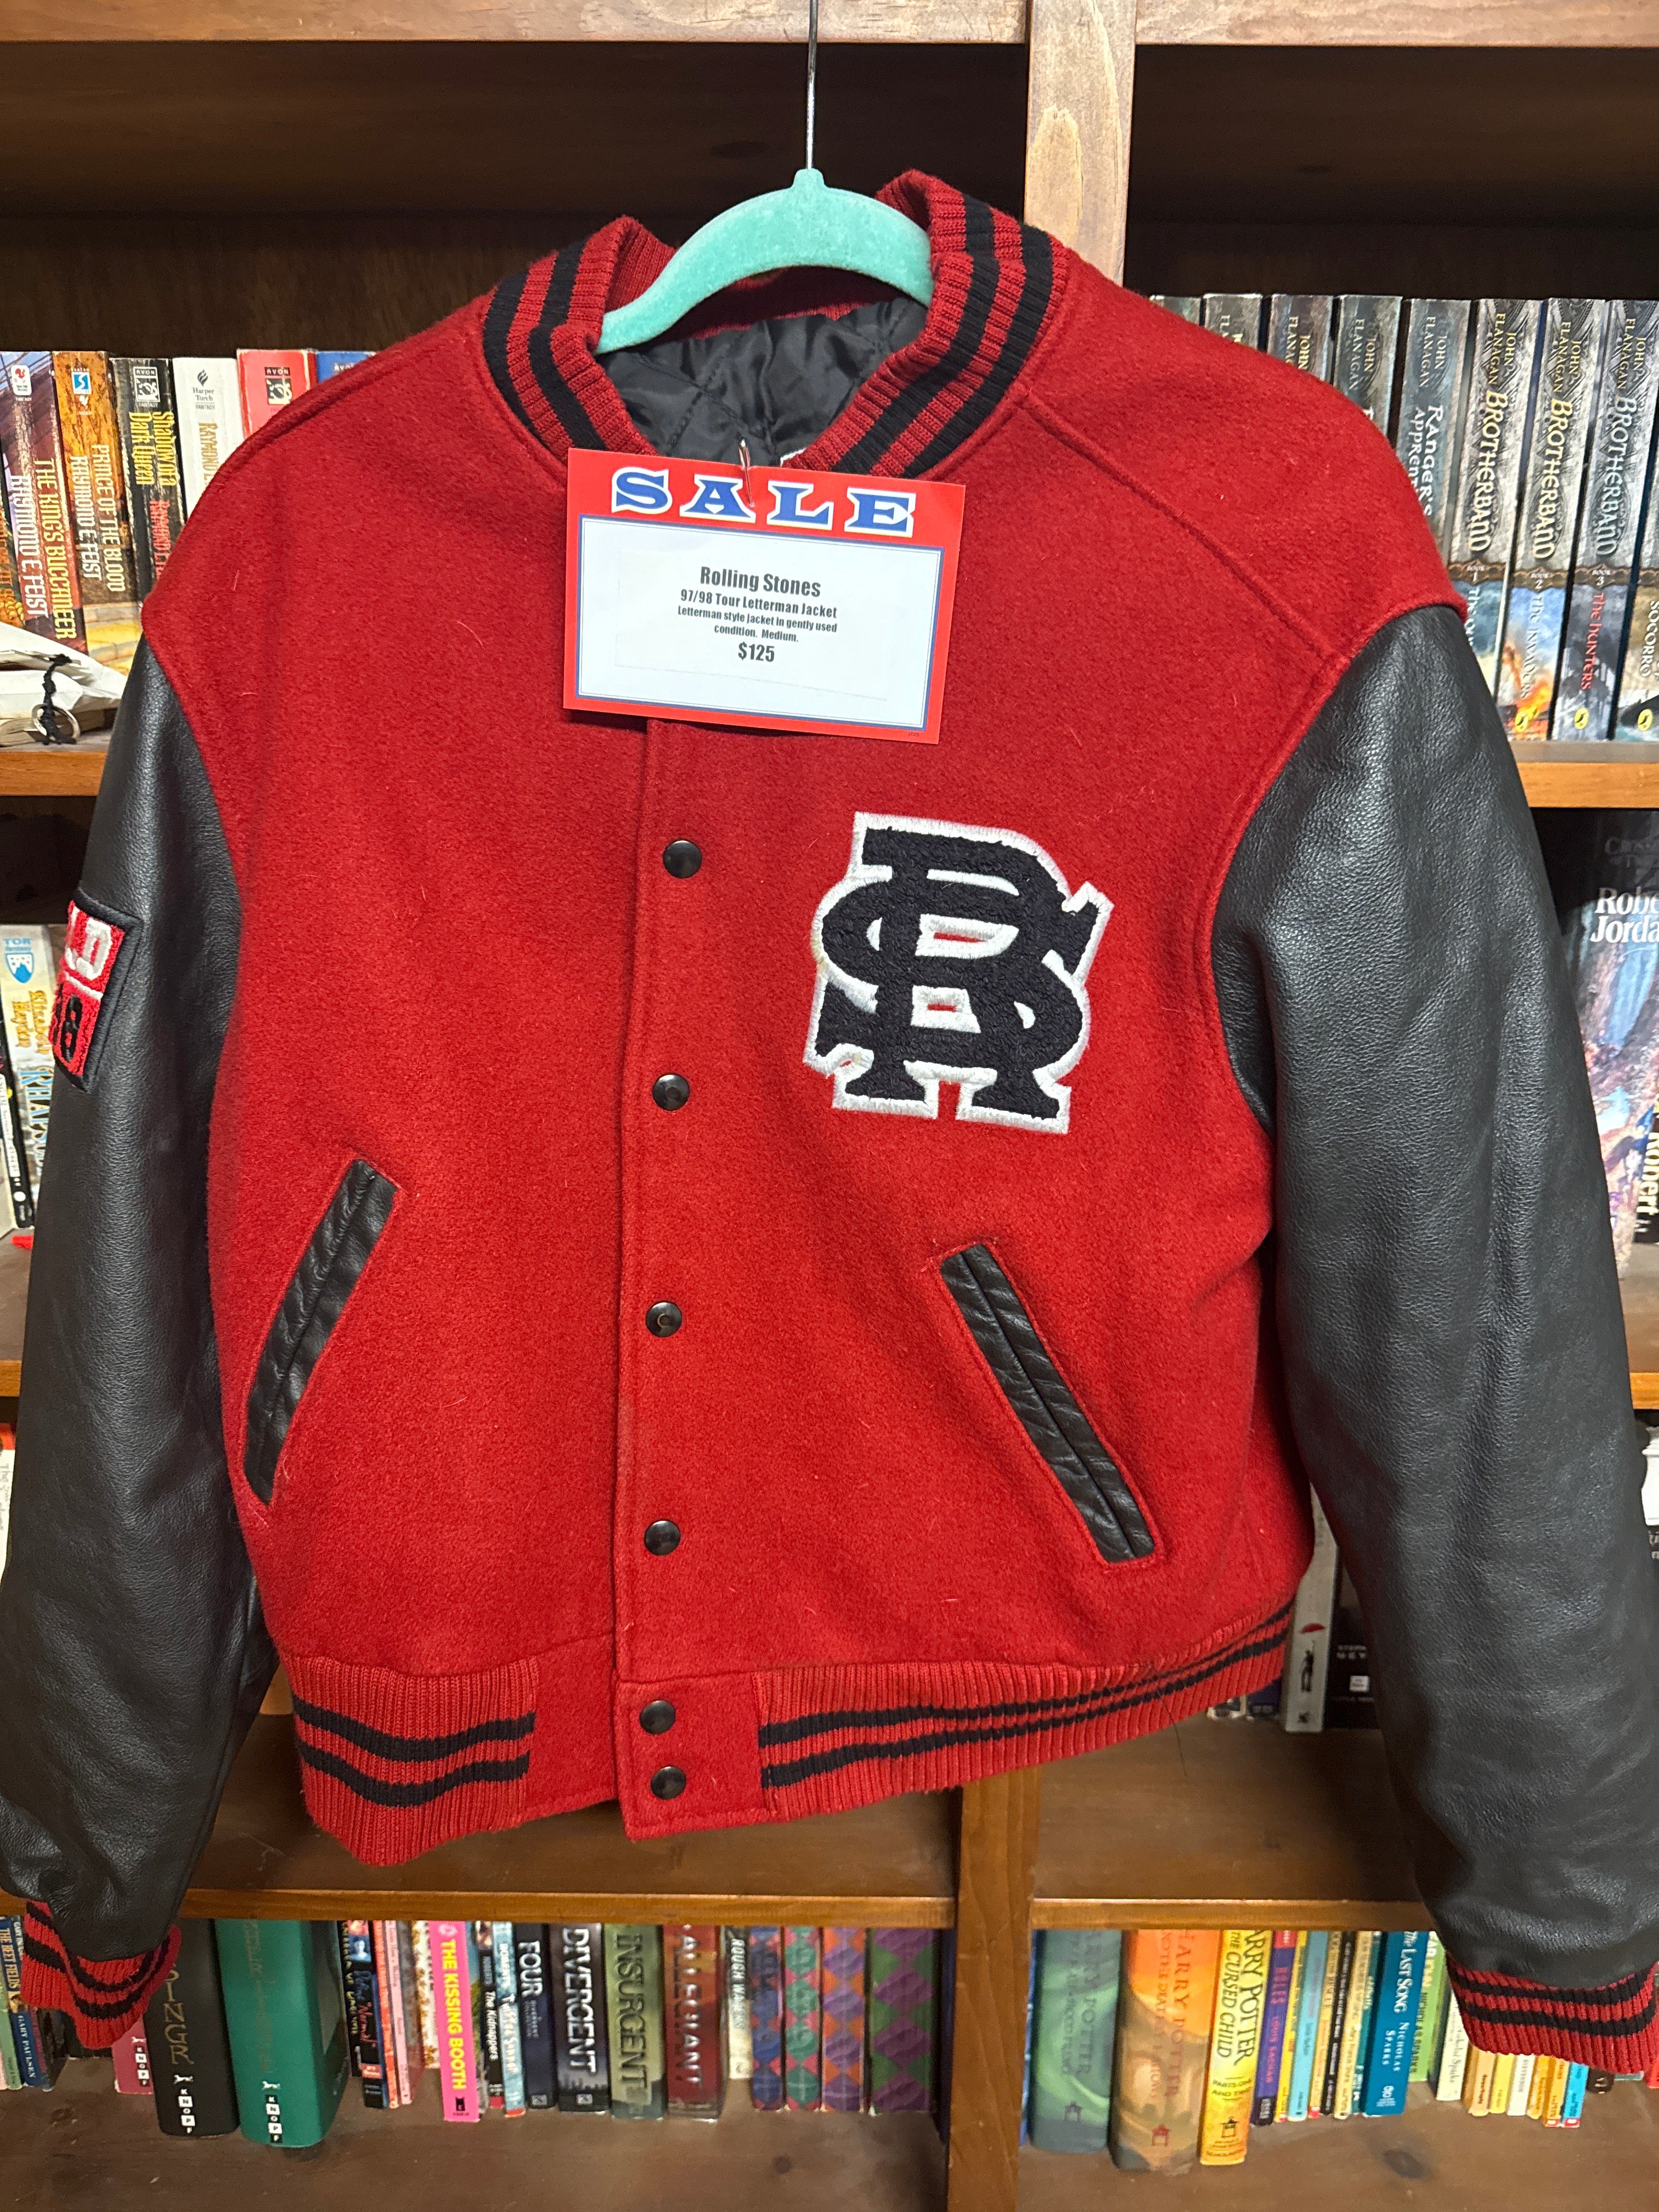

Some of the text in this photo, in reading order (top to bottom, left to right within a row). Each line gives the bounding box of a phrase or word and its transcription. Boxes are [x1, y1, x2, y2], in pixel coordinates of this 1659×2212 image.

[1285, 316, 1299, 364] FLANA
[1349, 318, 1365, 390] FLANAGAN
[1364, 337, 1378, 372] JOHN
[1419, 317, 1436, 387] FLANAGAN
[1435, 336, 1447, 370] JOHN
[1488, 313, 1505, 385] FLANAGAN
[1504, 332, 1517, 366] JOHN
[1553, 321, 1571, 393] FLANAGAN
[1568, 340, 1582, 374] JOHN
[1617, 318, 1635, 390] FLANAGAN
[1633, 337, 1646, 372] JOHN
[193, 387, 215, 396] Harper
[199, 422, 219, 471] RAYMOND
[10, 475, 42, 556] RAYMOND
[70, 455, 95, 527] RAYMOND
[612, 466, 916, 538] SALE
[91, 444, 126, 592] PRINCE OF THE BLOOD
[35, 458, 77, 640] THE KING'S BUCCANEER
[80, 542, 102, 580] FEIST
[700, 566, 821, 597] Rolling Stones
[1472, 572, 1478, 582] 1
[1536, 579, 1543, 589] 2
[1597, 576, 1605, 586] 3
[678, 606, 837, 633] Letterman style jacket in gently used
[680, 589, 837, 618] 97/98 Tour Letterman Jacket
[714, 625, 799, 642] condition. Medium.
[738, 641, 775, 662] $125
[1640, 601, 1659, 677] SOCORRO
[1595, 887, 1659, 915] Robe
[1590, 915, 1659, 943] Jorda
[10, 1001, 32, 1048] Haydon
[29, 990, 50, 1054] Elizabeth
[0, 1927, 21, 1989] THE BEET FIELDS
[441, 1939, 458, 1970] THE
[517, 1940, 543, 1998] FOUR
[731, 1937, 745, 1984] ROUGH
[1393, 1931, 1419, 2014] The LAST SONG
[443, 1973, 463, 2034] KISSING
[562, 1927, 597, 2075] DIVERGENT
[614, 1933, 648, 2089] INSURGENT
[673, 1934, 704, 2089] ALLEGIANT
[1217, 1932, 1241, 2058] THE CURSED CHILD
[1233, 1930, 1266, 2067] ARRY POTTER
[485, 1991, 499, 2061] The Kidnappers
[1382, 2029, 1396, 2067] SPARKS
[1393, 2021, 1410, 2072] NICHOLAS
[448, 2038, 467, 2090] BOOTH
[1164, 2017, 1186, 2098] POTTER
[178, 2087, 196, 2134] KNOPF
[265, 2095, 283, 2143] KNOPF
